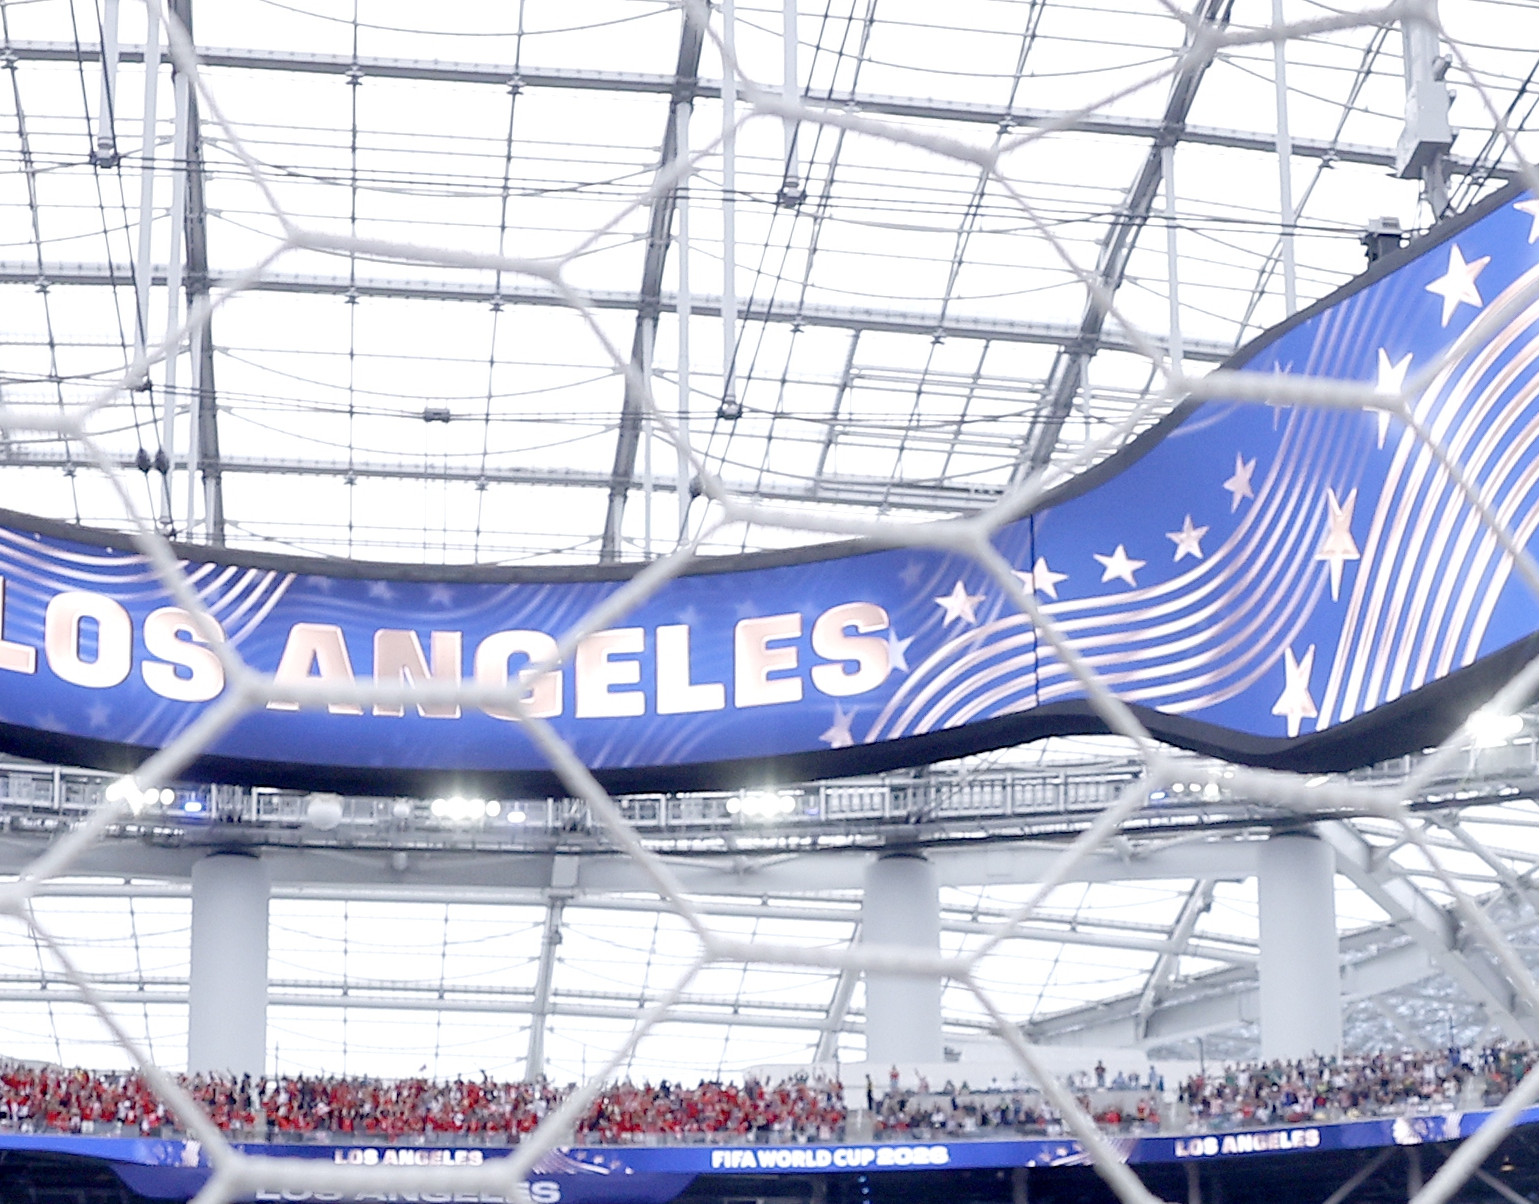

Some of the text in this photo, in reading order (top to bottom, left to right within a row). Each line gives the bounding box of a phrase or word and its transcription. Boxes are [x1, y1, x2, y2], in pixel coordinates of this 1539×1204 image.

[265, 601, 890, 721] ANGELES
[1175, 1129, 1321, 1157] LOS ANGELES
[334, 1149, 484, 1167] LOS ANGELES
[711, 1146, 948, 1168] FIFA WORLD CUP 2026
